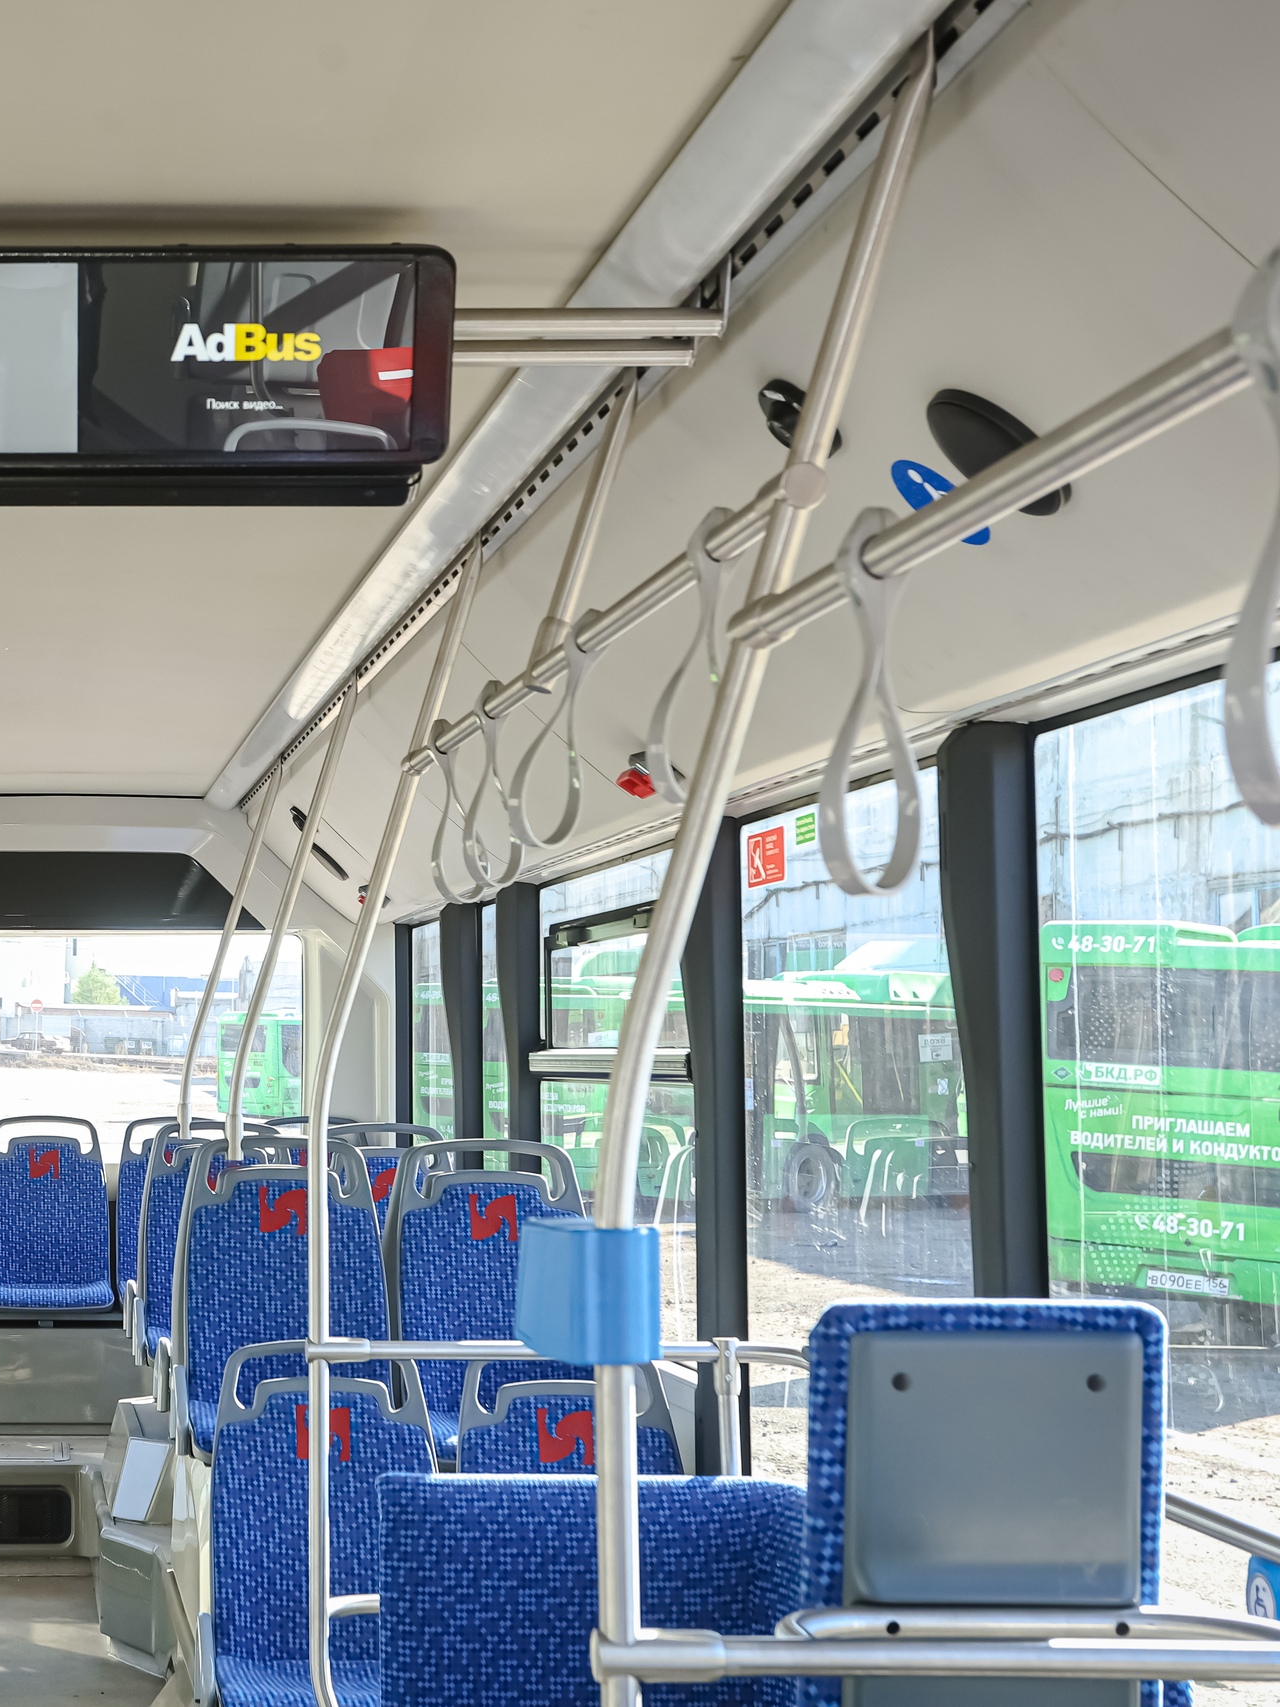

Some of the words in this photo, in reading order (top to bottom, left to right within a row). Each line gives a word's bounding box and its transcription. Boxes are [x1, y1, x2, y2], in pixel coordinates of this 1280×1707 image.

[170, 323, 322, 362] AdBus
[206, 398, 240, 410] Поиск
[1067, 935, 1156, 953] 48-30-71
[1095, 1066, 1157, 1082] БКД.РФ
[1064, 1097, 1109, 1111] Лучшие
[1089, 1104, 1123, 1119] нами!
[1131, 1115, 1251, 1138] ПРИГЛАШАЕМ
[1070, 1130, 1167, 1153] ВОДИТЕЛЕЙ
[1172, 1139, 1184, 1154] И
[1189, 1140, 1280, 1162] КОНДУКТО
[1152, 1215, 1245, 1241] 48-30-71
